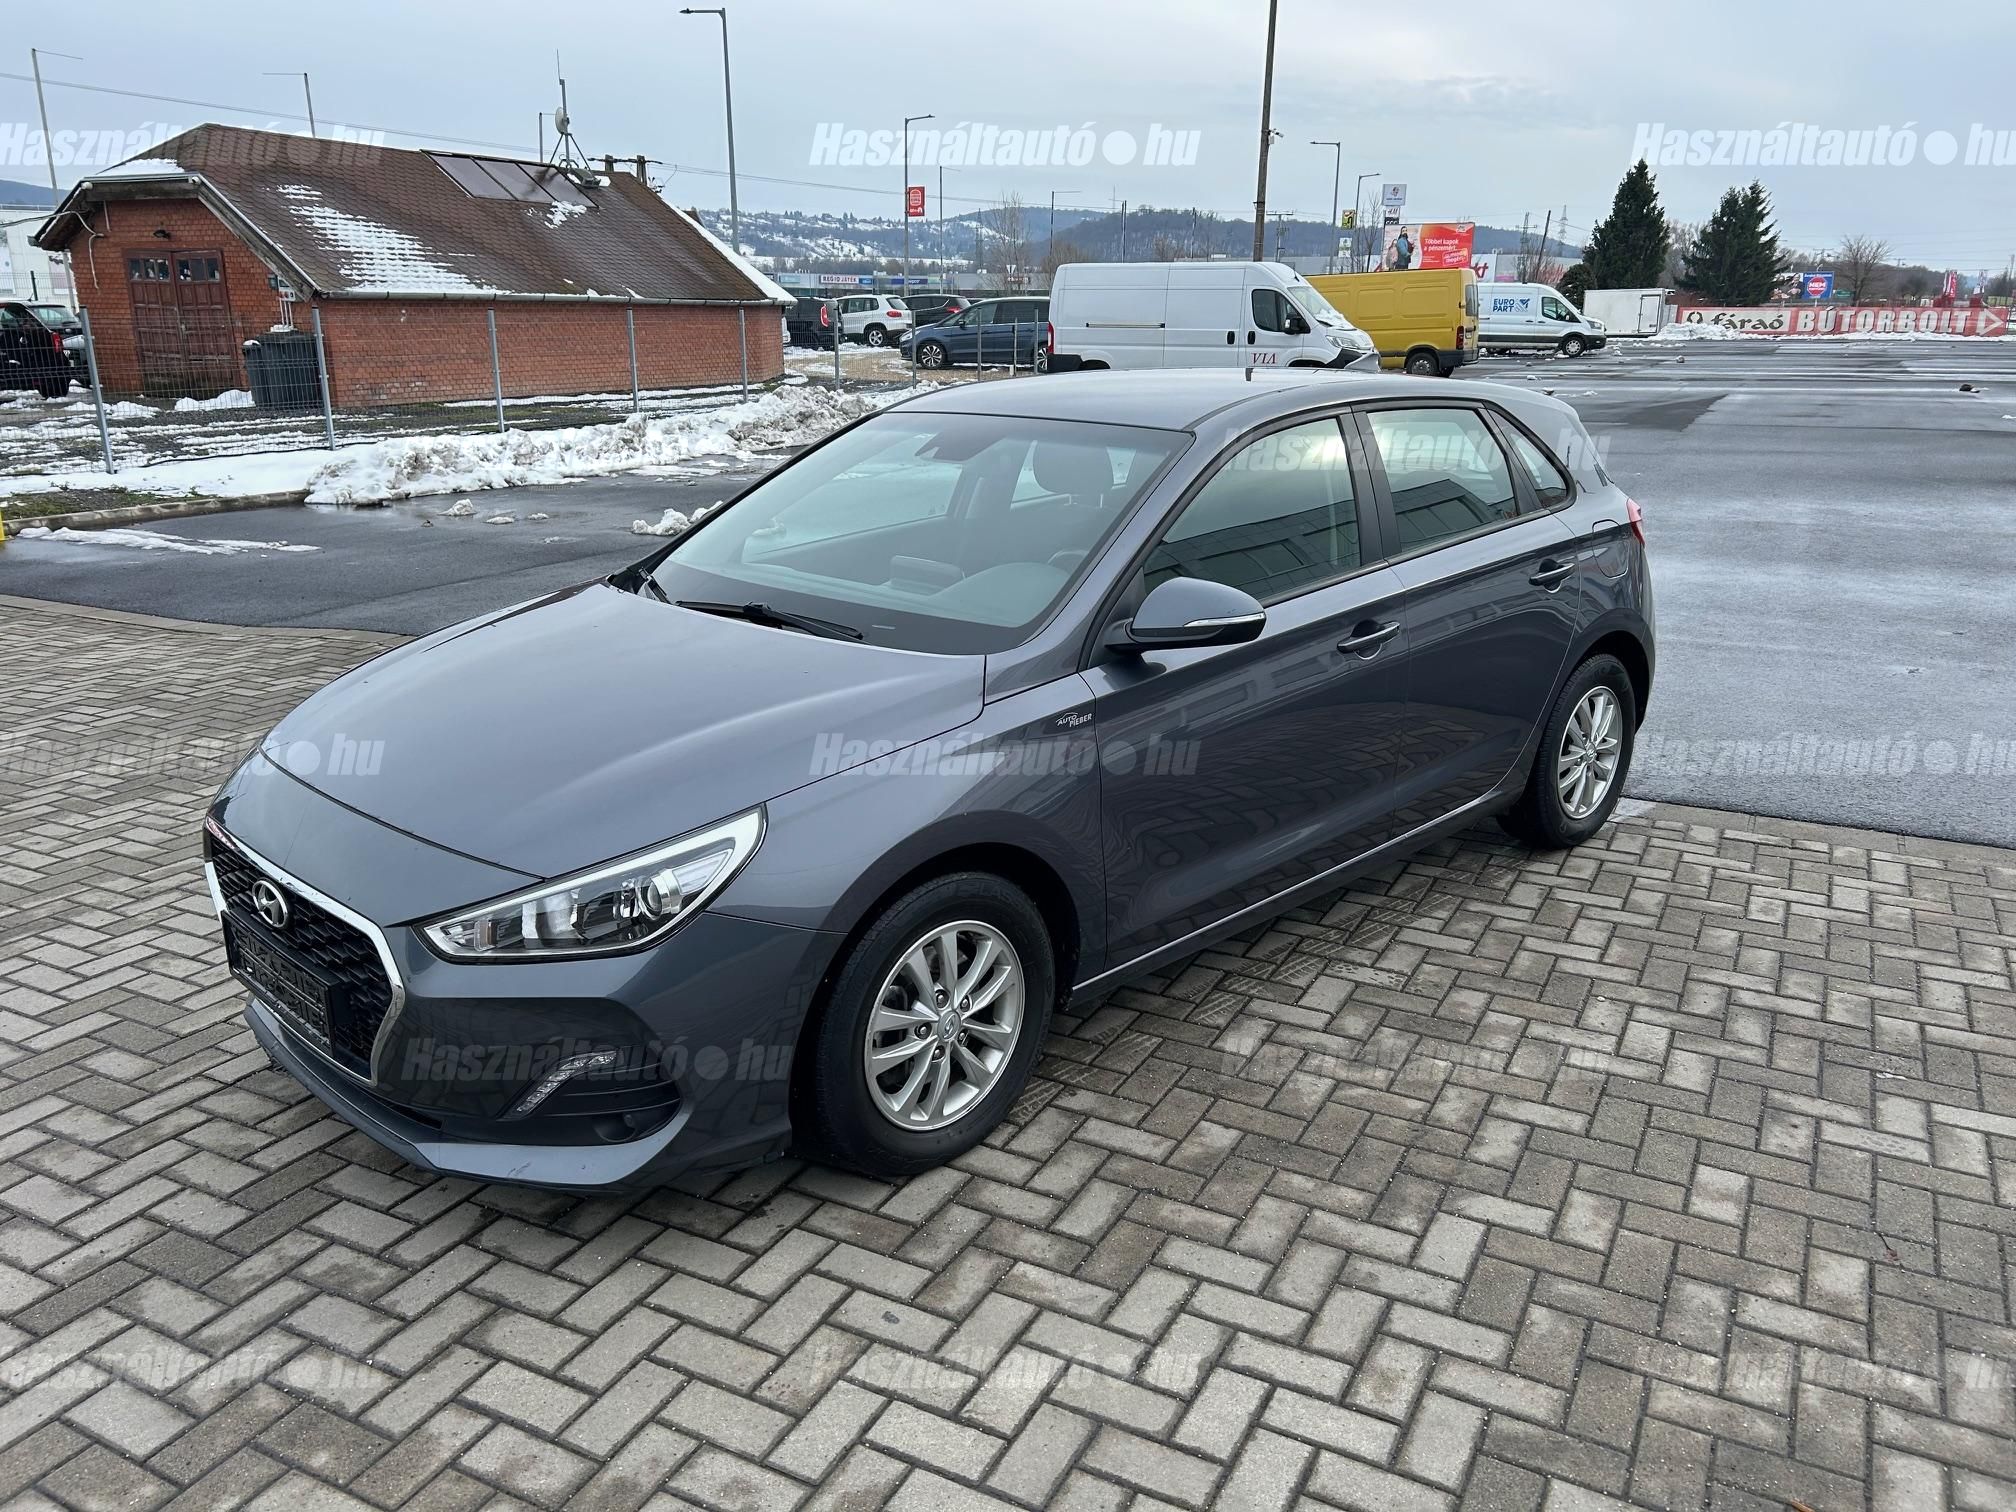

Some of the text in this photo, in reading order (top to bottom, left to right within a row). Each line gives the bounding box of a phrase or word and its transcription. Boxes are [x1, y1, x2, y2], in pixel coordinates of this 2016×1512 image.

[1493, 298, 1515, 306] EURO
[1492, 305, 1515, 313] PART
[1796, 306, 1973, 334] BÚTORBOLT
[1251, 352, 1277, 365] VIA
[1057, 714, 1078, 726] AUTO
